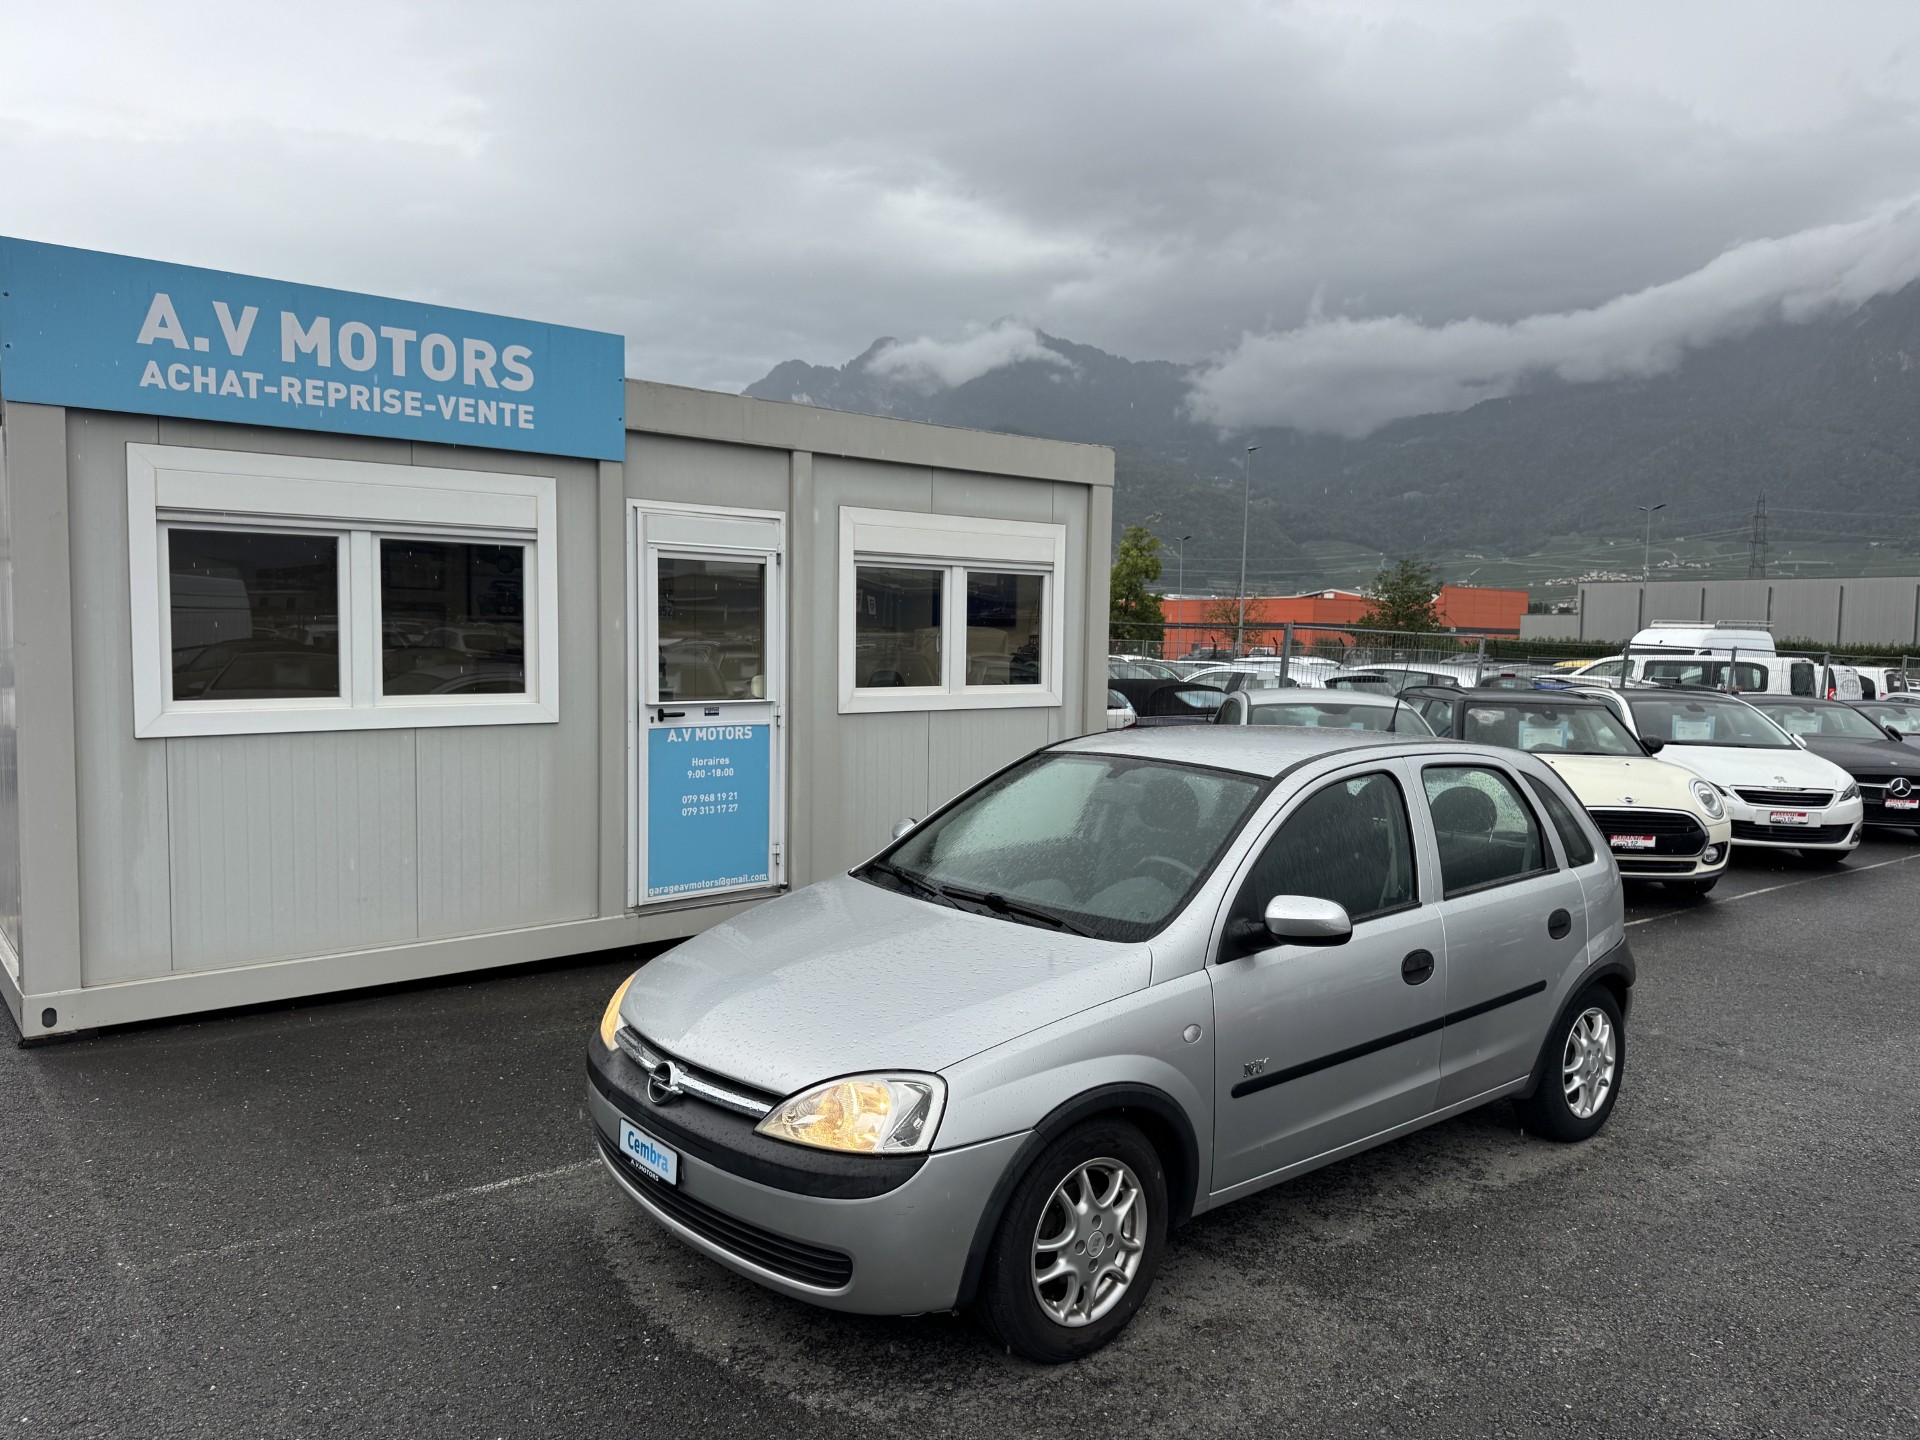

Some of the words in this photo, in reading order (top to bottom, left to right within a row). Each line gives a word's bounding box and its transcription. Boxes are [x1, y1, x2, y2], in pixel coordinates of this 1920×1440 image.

[136, 292, 259, 356] A.V
[280, 311, 534, 392] MOTORS
[139, 360, 534, 430] ACHAT-REPRISE-VENTE
[667, 728, 692, 742] A.V
[695, 726, 753, 741] MOTORS
[692, 757, 730, 767] Horaires
[687, 770, 706, 779] 9:00
[682, 795, 698, 804] 079
[699, 793, 715, 803] 968
[717, 792, 727, 802] 19
[728, 792, 738, 801] 21
[682, 807, 698, 816] 079
[699, 806, 715, 815] 313
[717, 804, 727, 814] 17
[728, 804, 738, 813] 27
[648, 873, 768, 897] garageavmotors@gmail.com
[627, 1130, 669, 1173] Cembra
